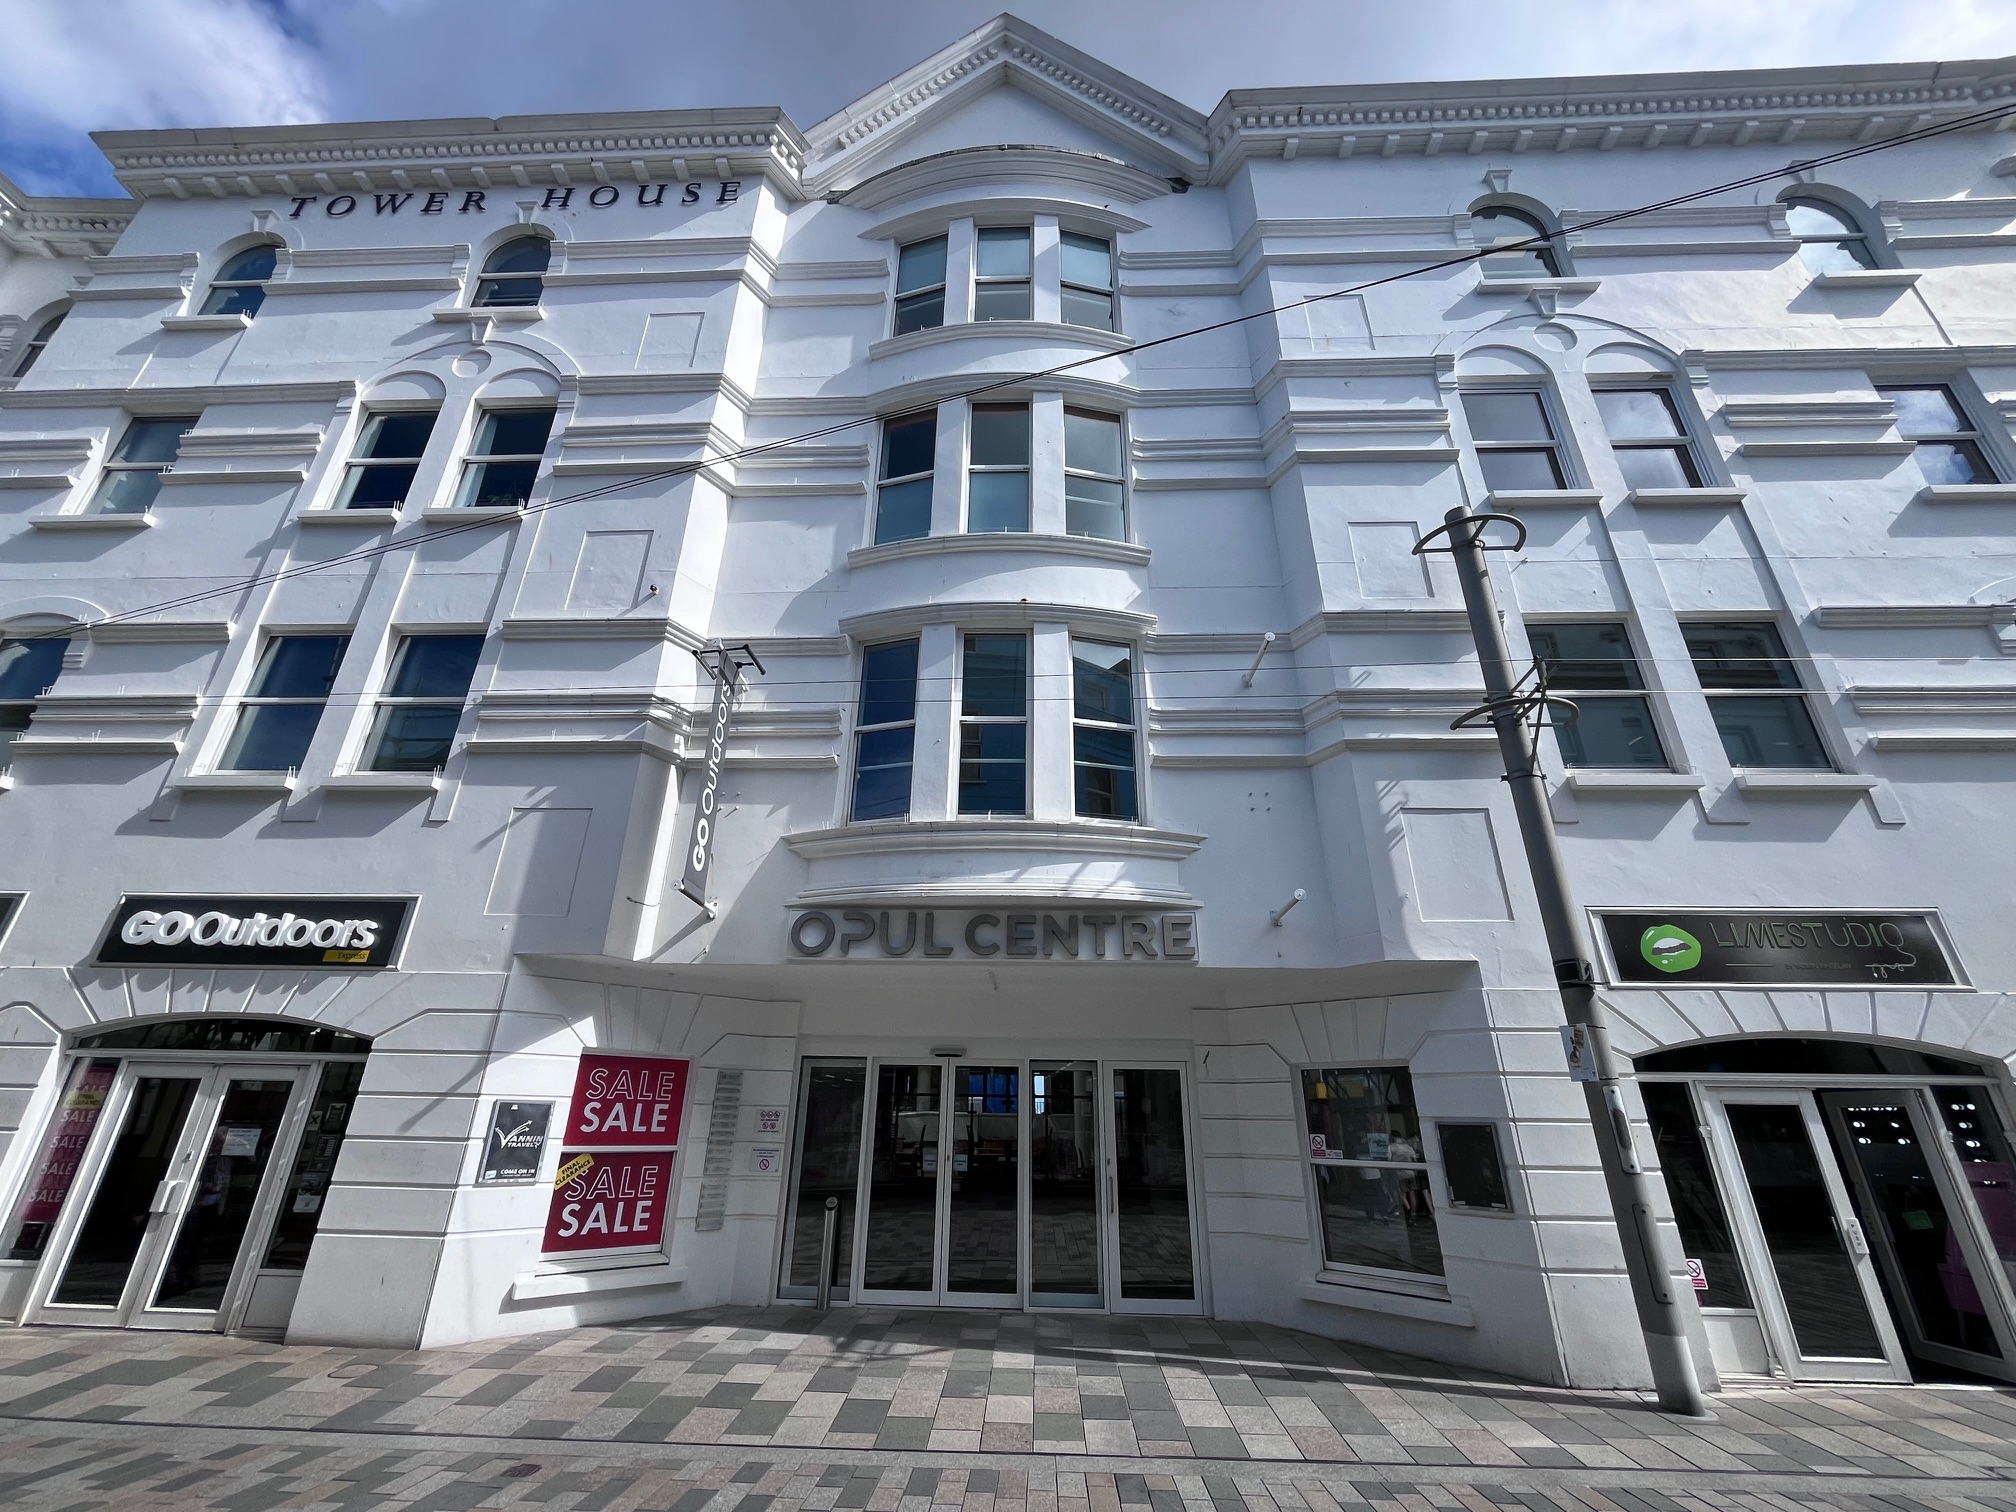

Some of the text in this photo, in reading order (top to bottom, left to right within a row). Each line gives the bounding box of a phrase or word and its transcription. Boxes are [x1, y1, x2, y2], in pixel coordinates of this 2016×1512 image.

[289, 181, 741, 218] TOWER HOUSE
[790, 910, 1197, 957] OPUL CENTRE
[337, 952, 367, 960] Express
[585, 1067, 675, 1101] SALE
[60, 1110, 96, 1123] SALE
[579, 1101, 670, 1133] SALE
[49, 1136, 86, 1149] SALE
[39, 1162, 75, 1175] SALE
[555, 1159, 592, 1187] CLEARANCE
[561, 1160, 581, 1176] FINAL
[29, 1189, 65, 1202] SALE
[564, 1166, 659, 1201] SALE
[557, 1200, 653, 1238] SALE
